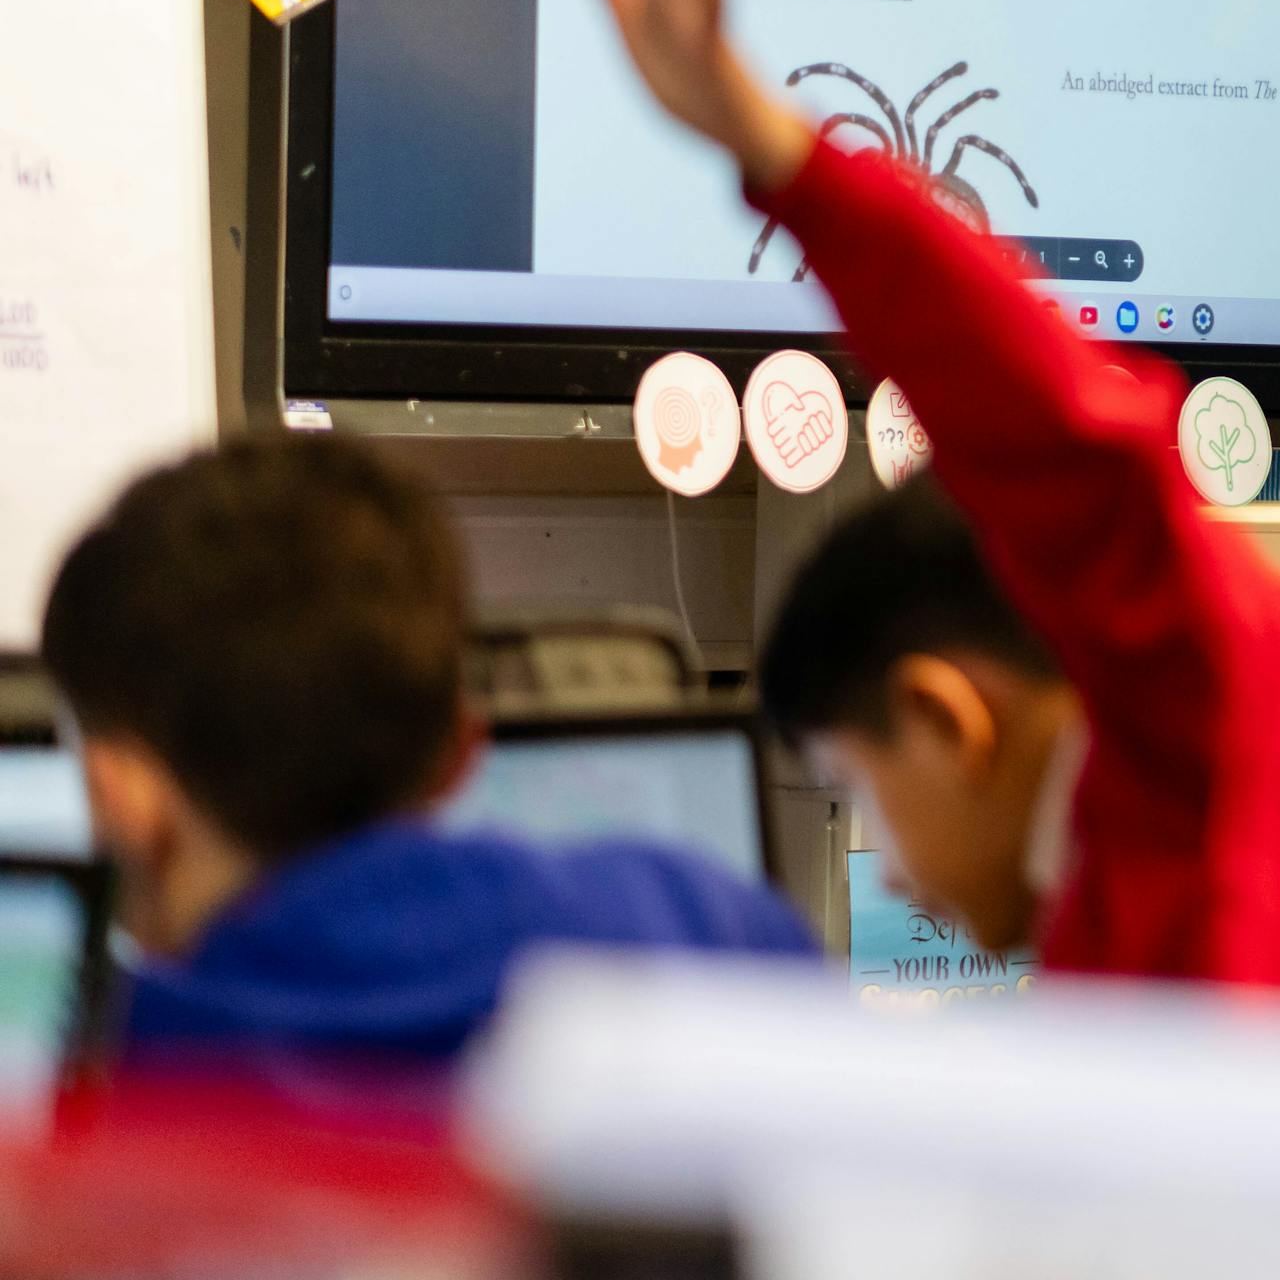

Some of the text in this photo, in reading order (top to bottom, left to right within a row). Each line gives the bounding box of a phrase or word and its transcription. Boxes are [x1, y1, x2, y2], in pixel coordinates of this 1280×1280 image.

[1061, 70, 1084, 90] An
[1088, 71, 1154, 98] abridged
[1158, 78, 1208, 95] extract
[1213, 78, 1249, 97] from
[1254, 80, 1277, 99] The
[893, 953, 1008, 982] YOUR OWN
